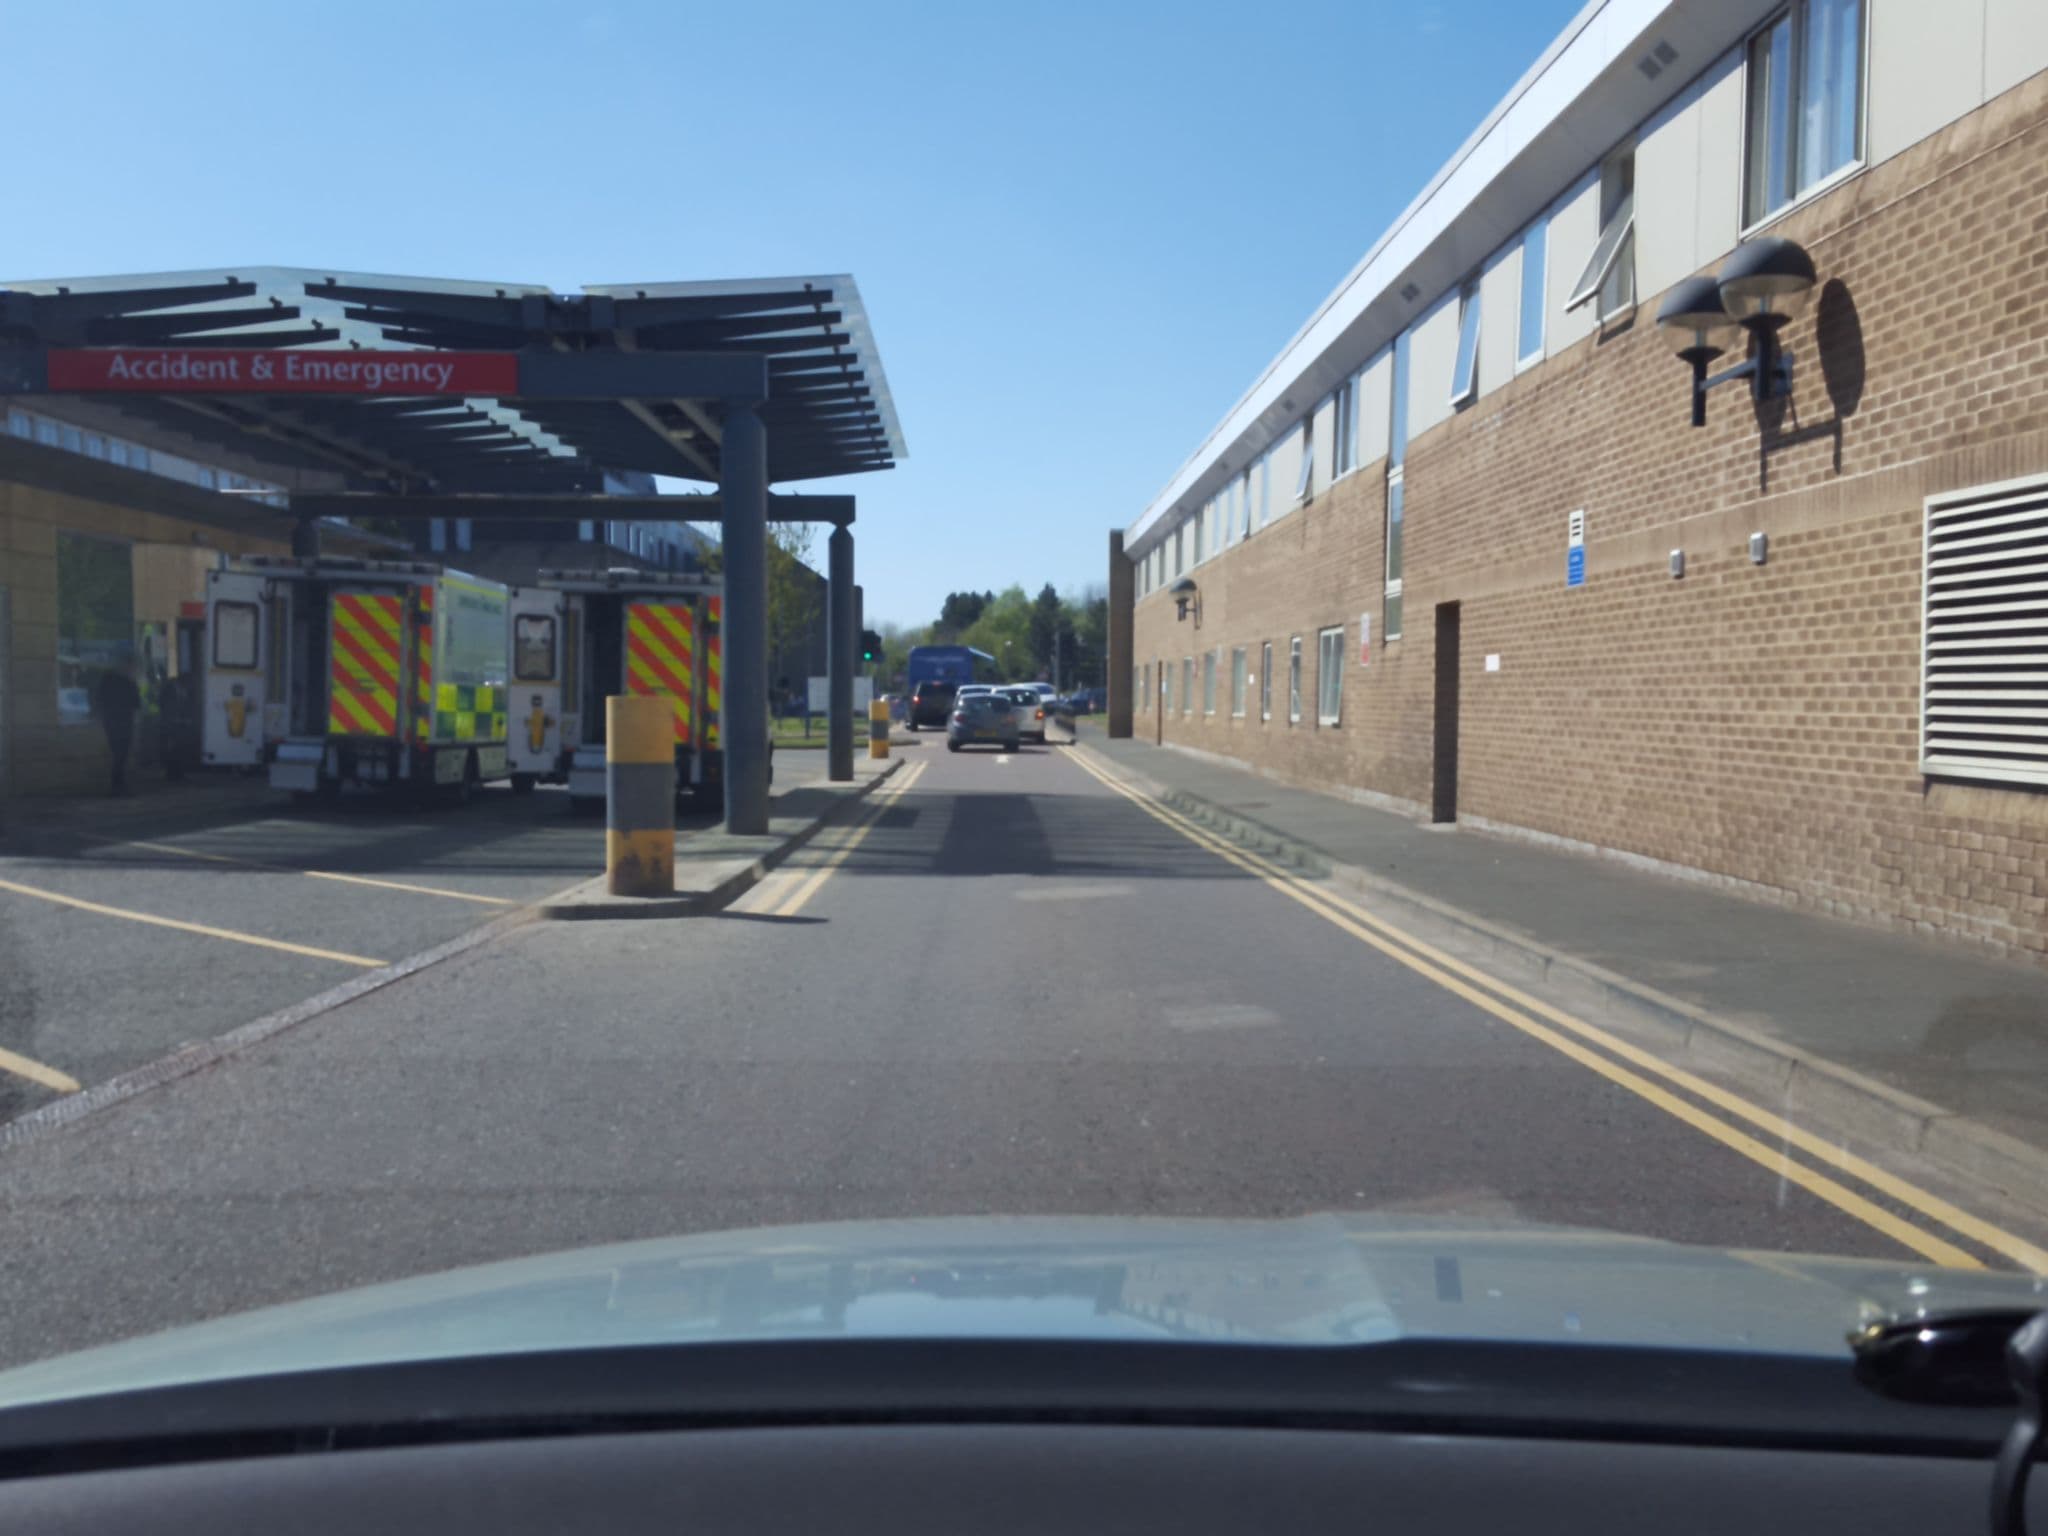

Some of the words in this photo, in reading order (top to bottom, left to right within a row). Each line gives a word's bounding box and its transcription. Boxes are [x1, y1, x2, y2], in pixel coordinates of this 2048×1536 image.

[108, 353, 240, 380] Accident
[252, 355, 273, 380] &
[287, 355, 454, 390] Emergency
